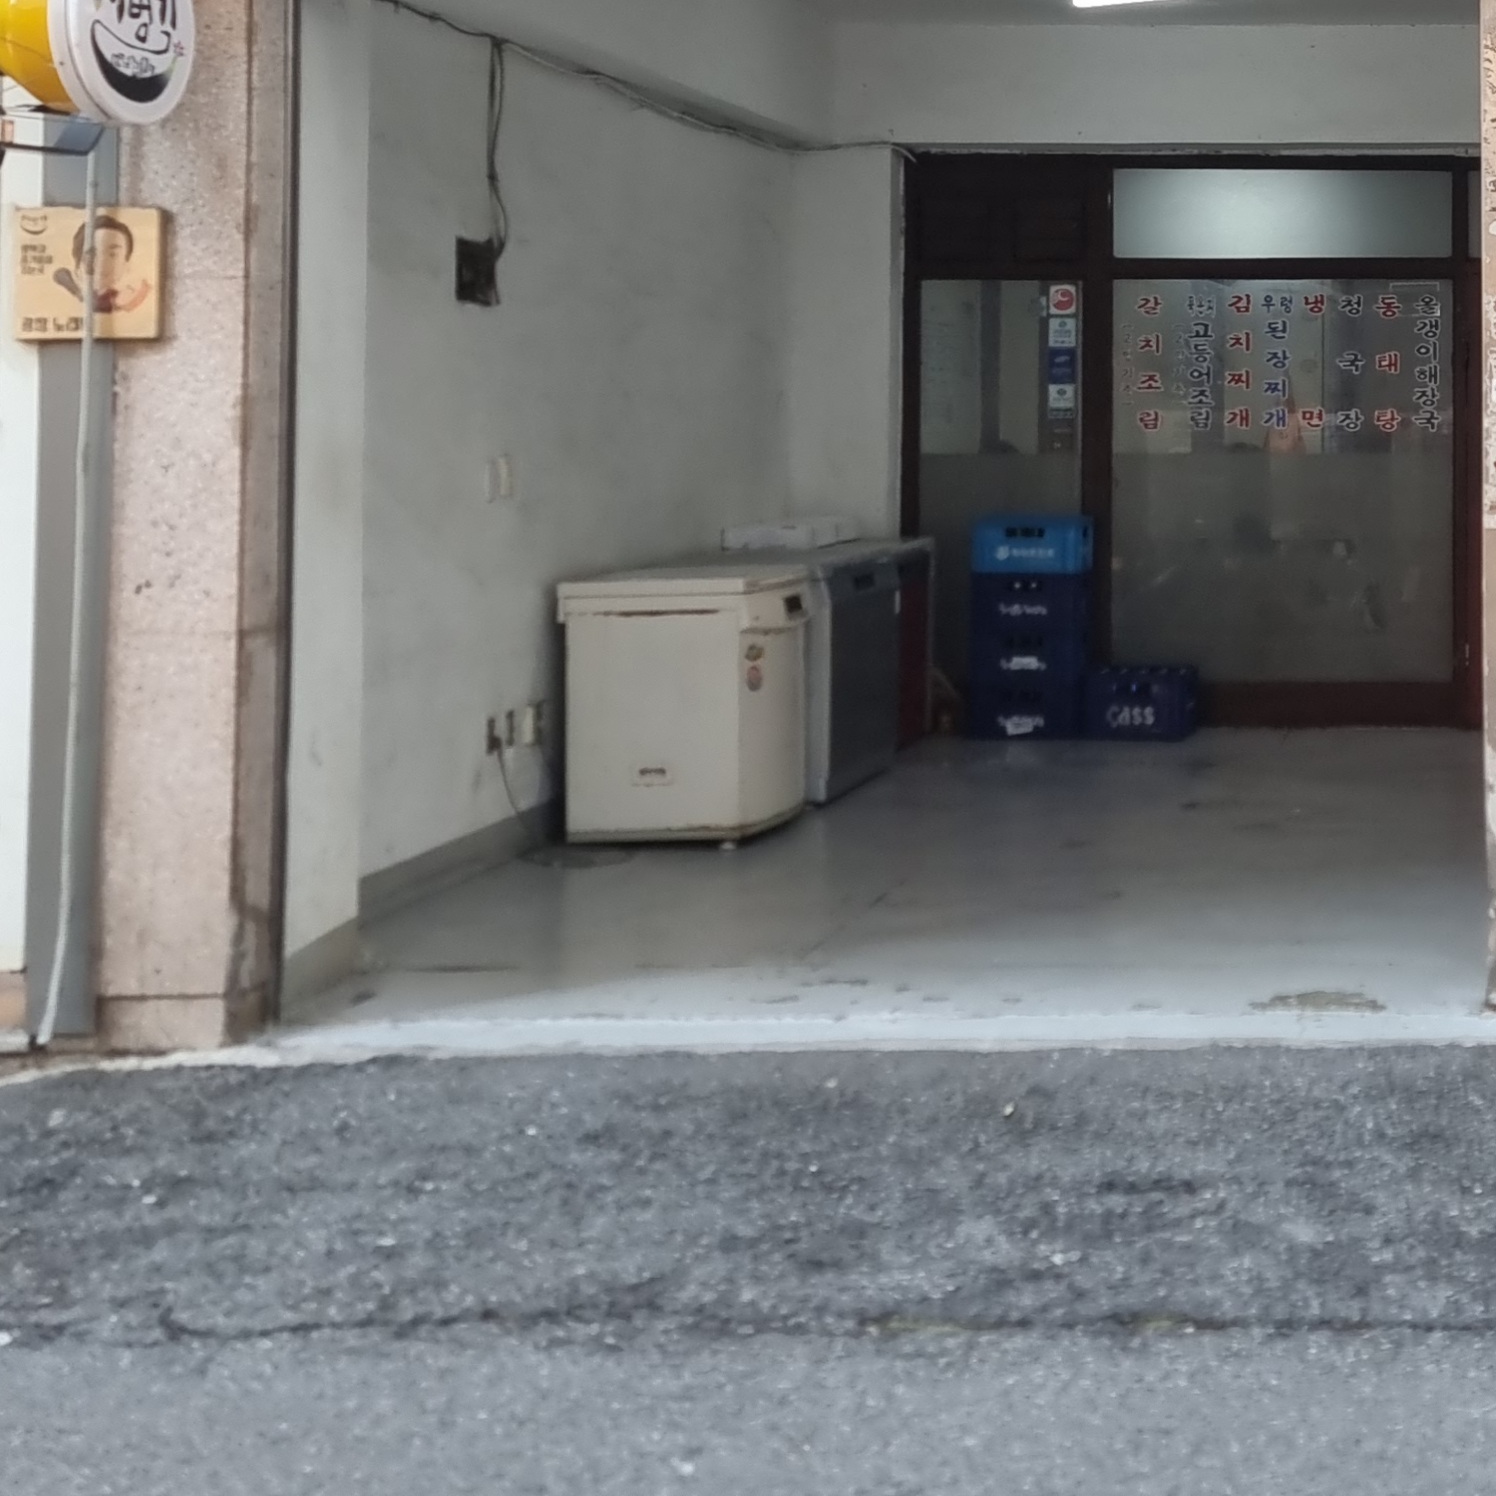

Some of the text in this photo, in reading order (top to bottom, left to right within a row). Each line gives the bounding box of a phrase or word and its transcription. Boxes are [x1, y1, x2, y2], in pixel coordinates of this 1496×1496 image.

[1137, 295, 1163, 431] 갈치조림
[1187, 320, 1215, 431] 고등어조림
[1226, 293, 1252, 429] 김치찌개
[1261, 294, 1293, 429] 우렁 된장찌개
[1302, 293, 1325, 429] 냉면
[1337, 294, 1366, 431] 청국장
[1373, 294, 1402, 431] 동태탕
[1413, 294, 1441, 432] 올갱이해장국
